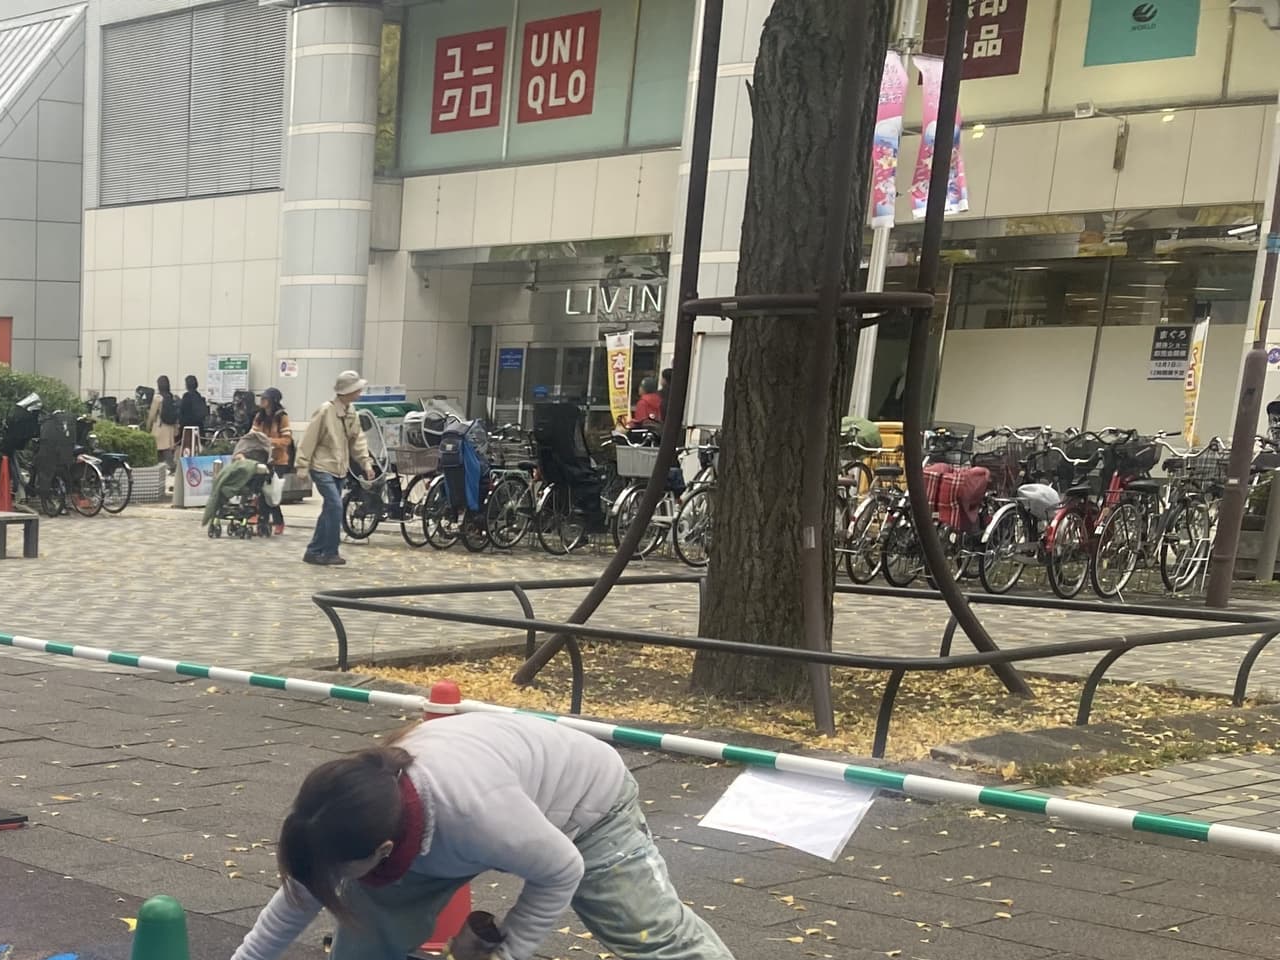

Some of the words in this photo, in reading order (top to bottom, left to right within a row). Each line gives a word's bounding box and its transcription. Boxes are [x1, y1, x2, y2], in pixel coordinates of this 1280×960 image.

[443, 41, 494, 81] ユニ
[530, 26, 585, 67] UNI
[438, 83, 493, 122] クロ
[527, 69, 586, 115] QLO
[565, 285, 662, 315] LIVIN
[611, 351, 627, 390] 本日
